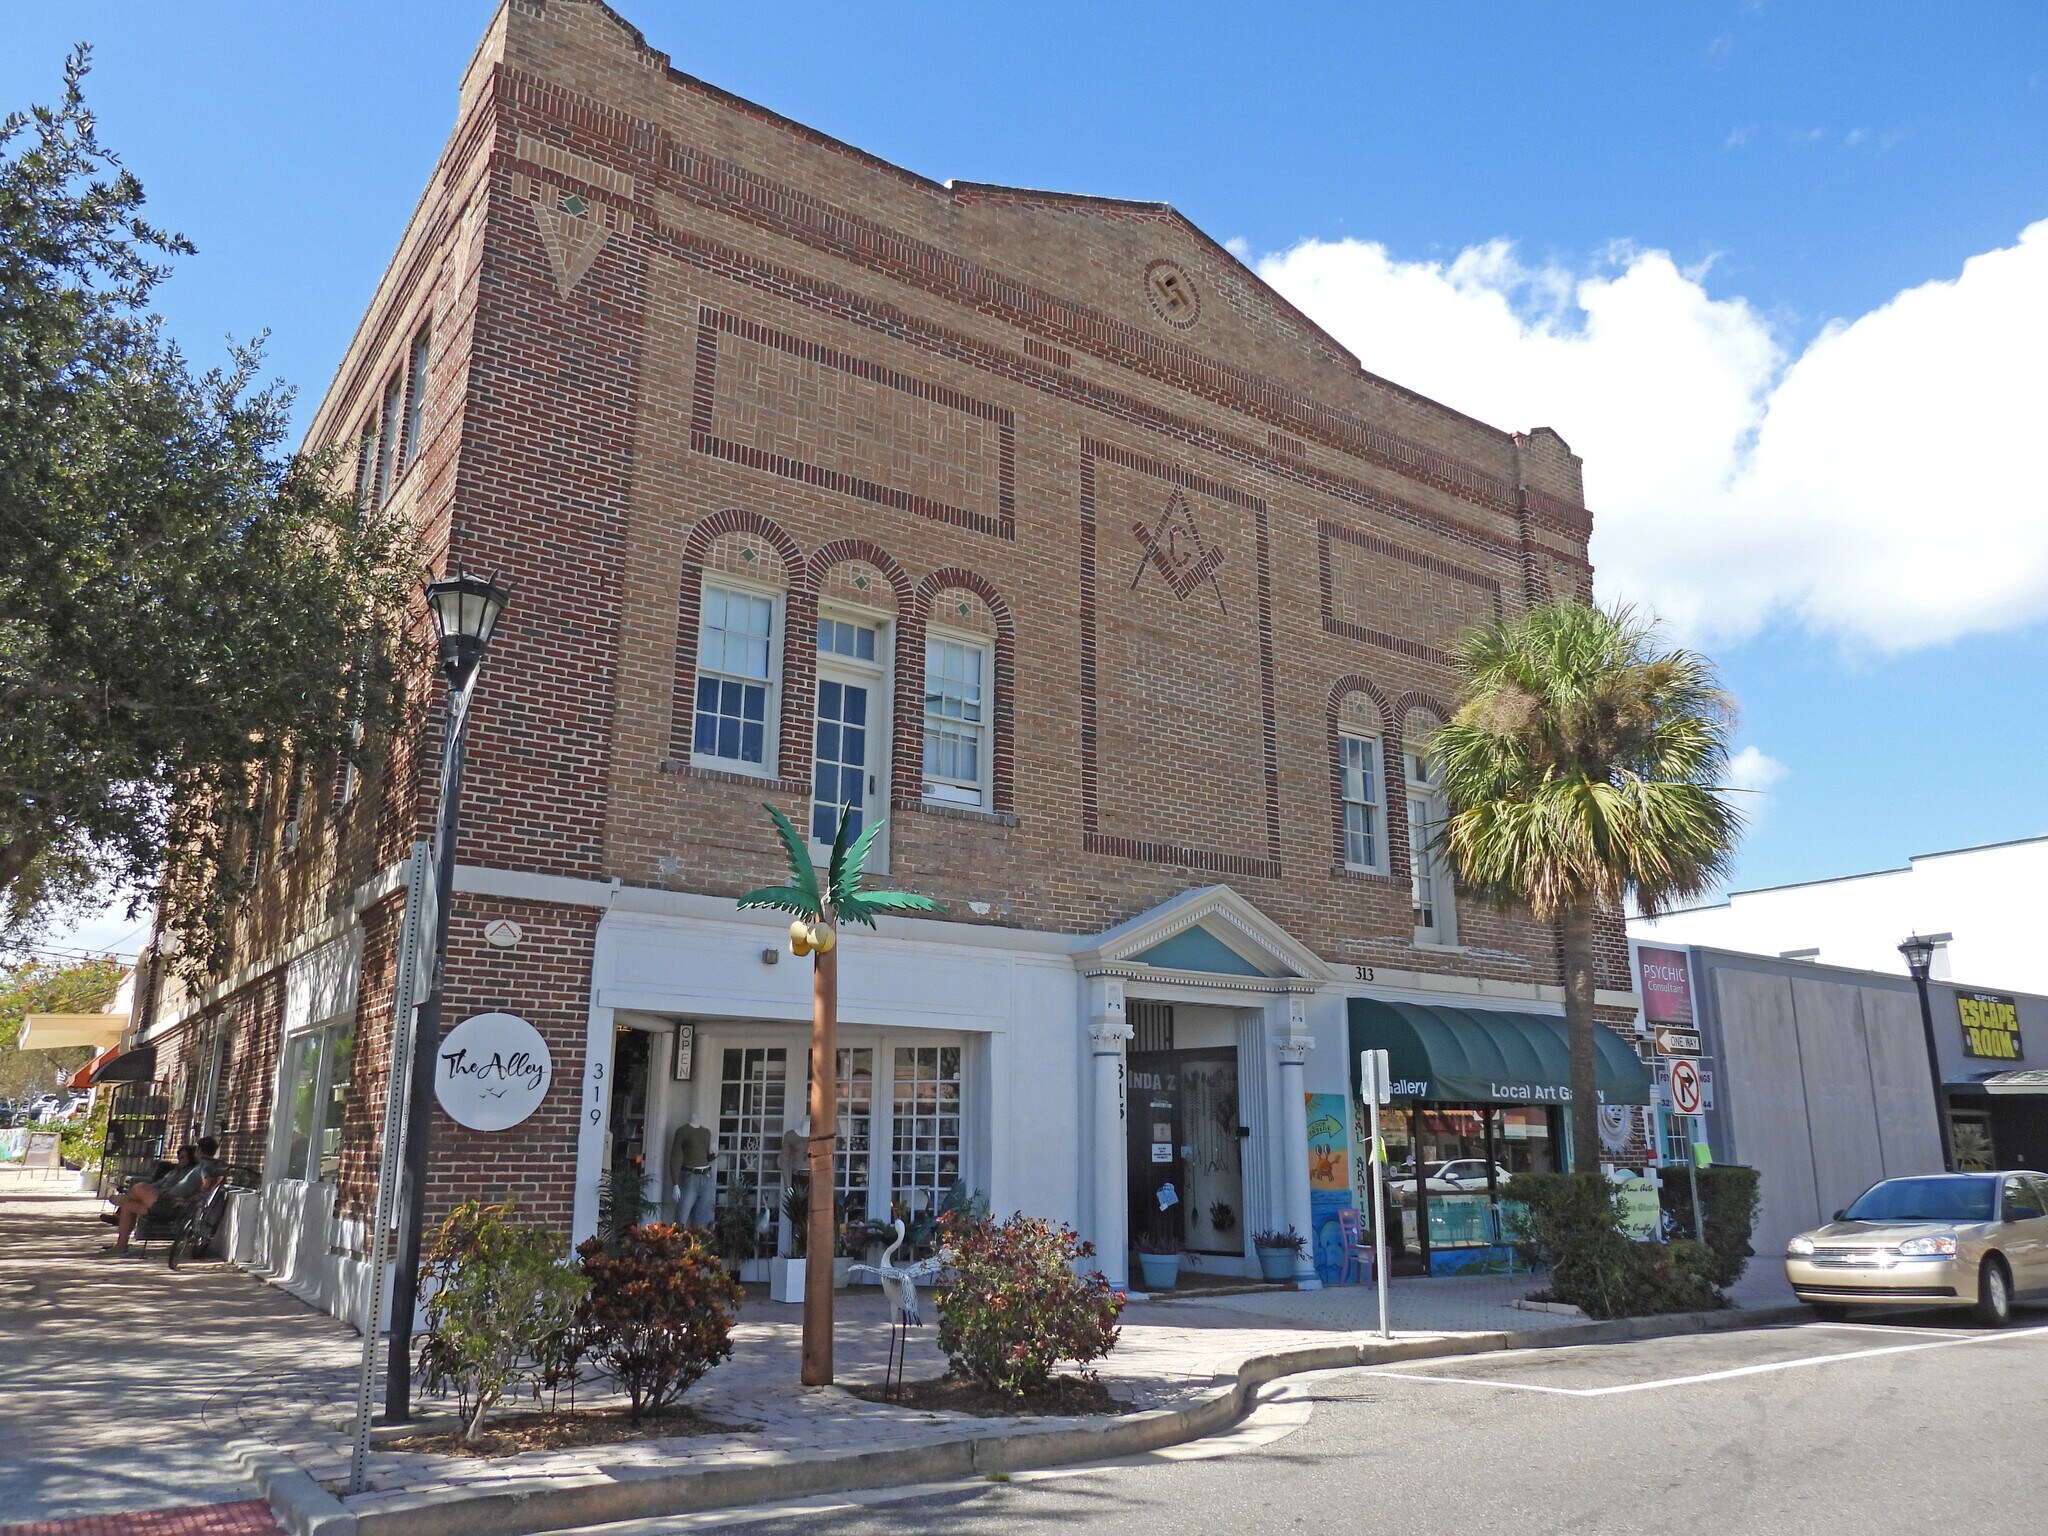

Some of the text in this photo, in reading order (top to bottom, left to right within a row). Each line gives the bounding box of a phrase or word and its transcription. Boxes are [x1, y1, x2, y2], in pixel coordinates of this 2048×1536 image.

[1355, 966, 1374, 982] 313
[1643, 964, 1686, 983] PSYCHIC
[1647, 980, 1684, 994] Consultant
[1974, 994, 1998, 1003] EPIC
[1957, 998, 2018, 1032] ESCAPE
[1670, 1035, 1698, 1048] ONE WAY
[1969, 1027, 2016, 1058] ROOM
[679, 1026, 691, 1078] OPEN
[441, 1048, 548, 1091] The Alley
[590, 1062, 603, 1126] 319
[1491, 1082, 1530, 1099] Local
[1534, 1084, 1556, 1101] Art
